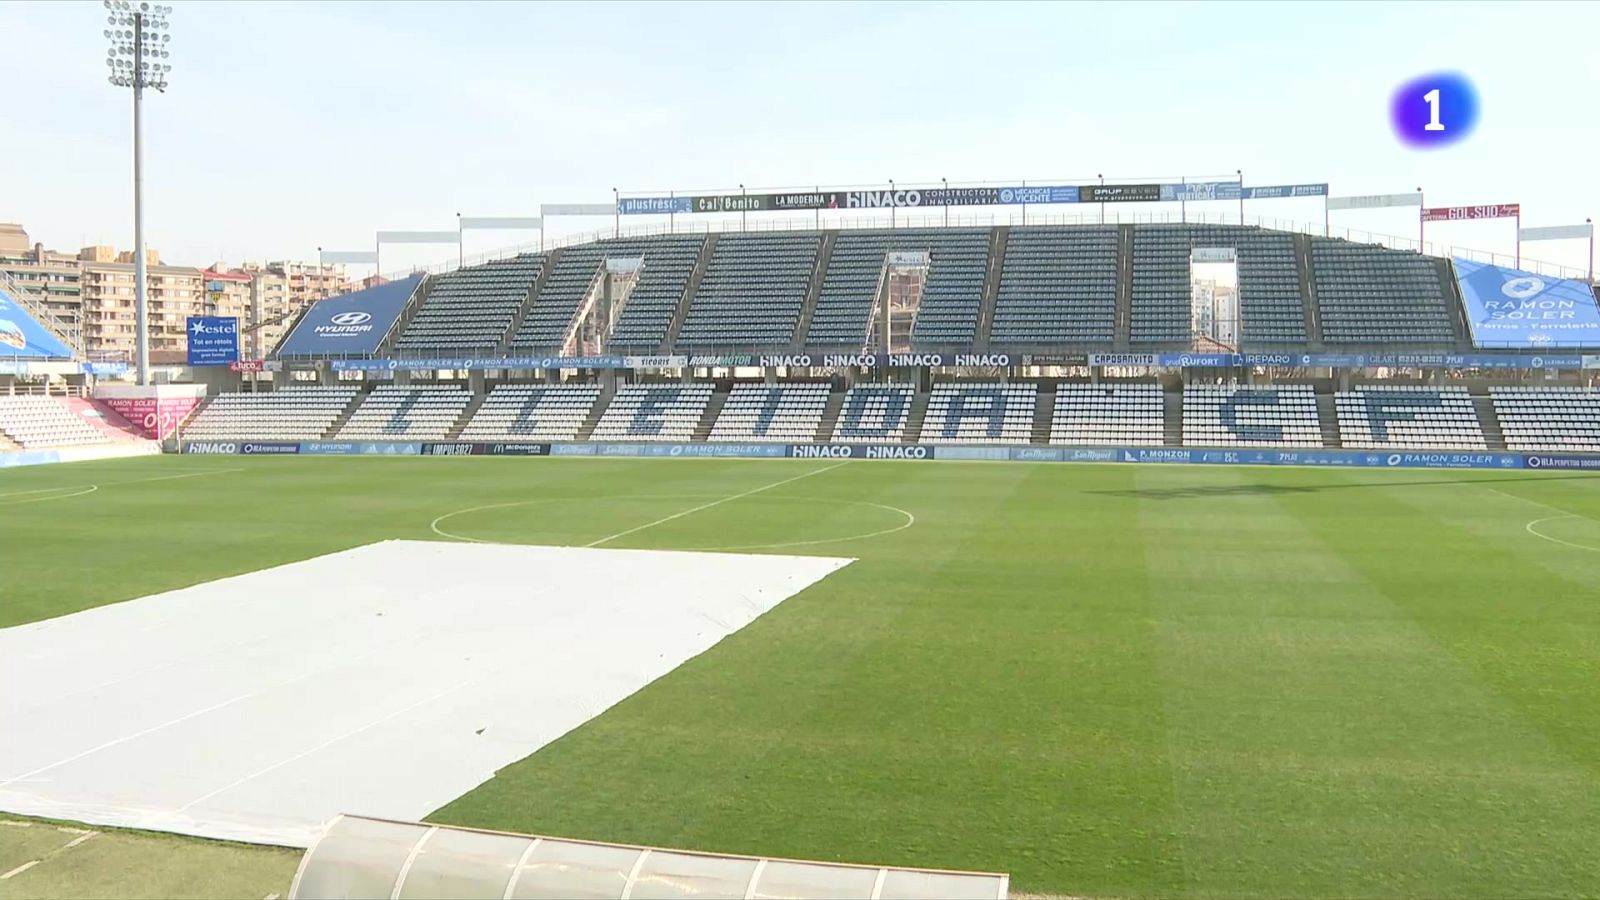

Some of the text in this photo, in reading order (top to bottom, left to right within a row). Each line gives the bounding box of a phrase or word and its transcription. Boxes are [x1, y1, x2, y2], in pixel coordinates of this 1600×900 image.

[924, 188, 998, 198] CONSTRUCTORA
[1015, 193, 1051, 204] VICENTE
[775, 193, 825, 205] LA MODERNA
[846, 190, 921, 208] HINACO
[924, 197, 998, 207] INMOBILIARIA
[1448, 205, 1499, 220] GOL-SUD
[1484, 300, 1574, 310] RAMON
[1491, 310, 1576, 320] SOLER
[204, 323, 236, 334] estel
[314, 324, 373, 333] HYUNDAI
[503, 358, 530, 366] SOLER
[759, 355, 811, 367] HINACO
[823, 355, 876, 367] HINACO
[888, 355, 942, 367] HINACO
[955, 355, 1009, 367] HINACO
[188, 443, 236, 454] HINACO
[684, 445, 761, 455] RAMON SOLER
[792, 445, 852, 458] HINACO
[866, 445, 927, 459] HINACO
[1404, 454, 1448, 464] RAMON
[1451, 454, 1493, 464] SOLER
